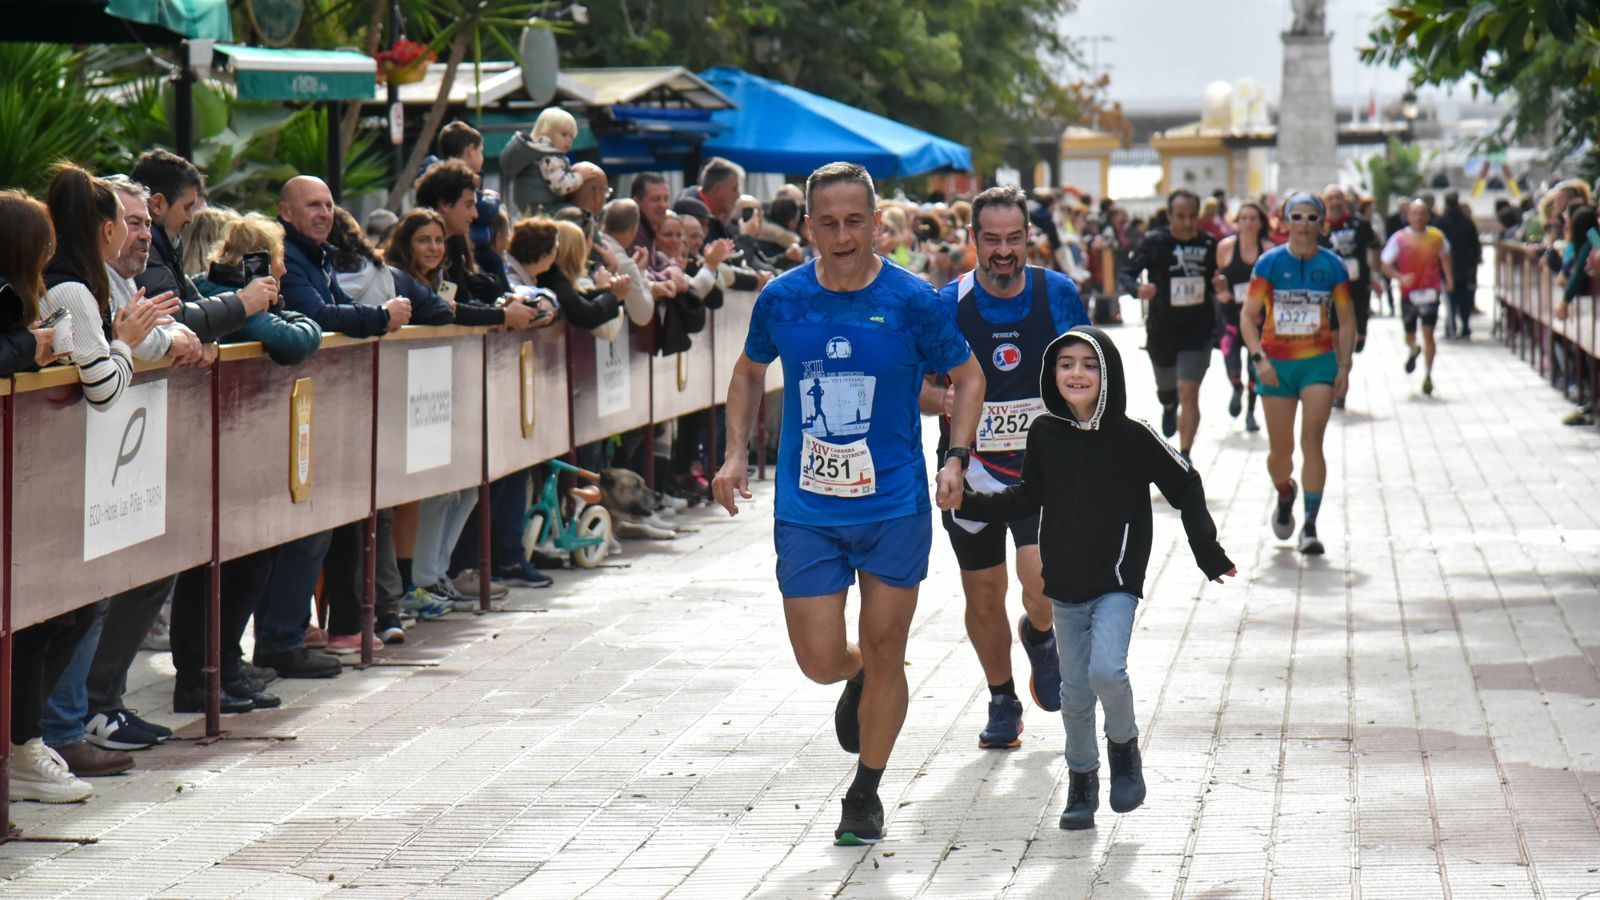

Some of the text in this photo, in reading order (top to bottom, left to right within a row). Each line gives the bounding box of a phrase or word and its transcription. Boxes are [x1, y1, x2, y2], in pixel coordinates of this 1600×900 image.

[987, 405, 1009, 415] XIV
[994, 413, 1028, 434] 252
[811, 441, 829, 456] XIV
[842, 450, 867, 459] ESTRECHO
[815, 455, 850, 479] 251
